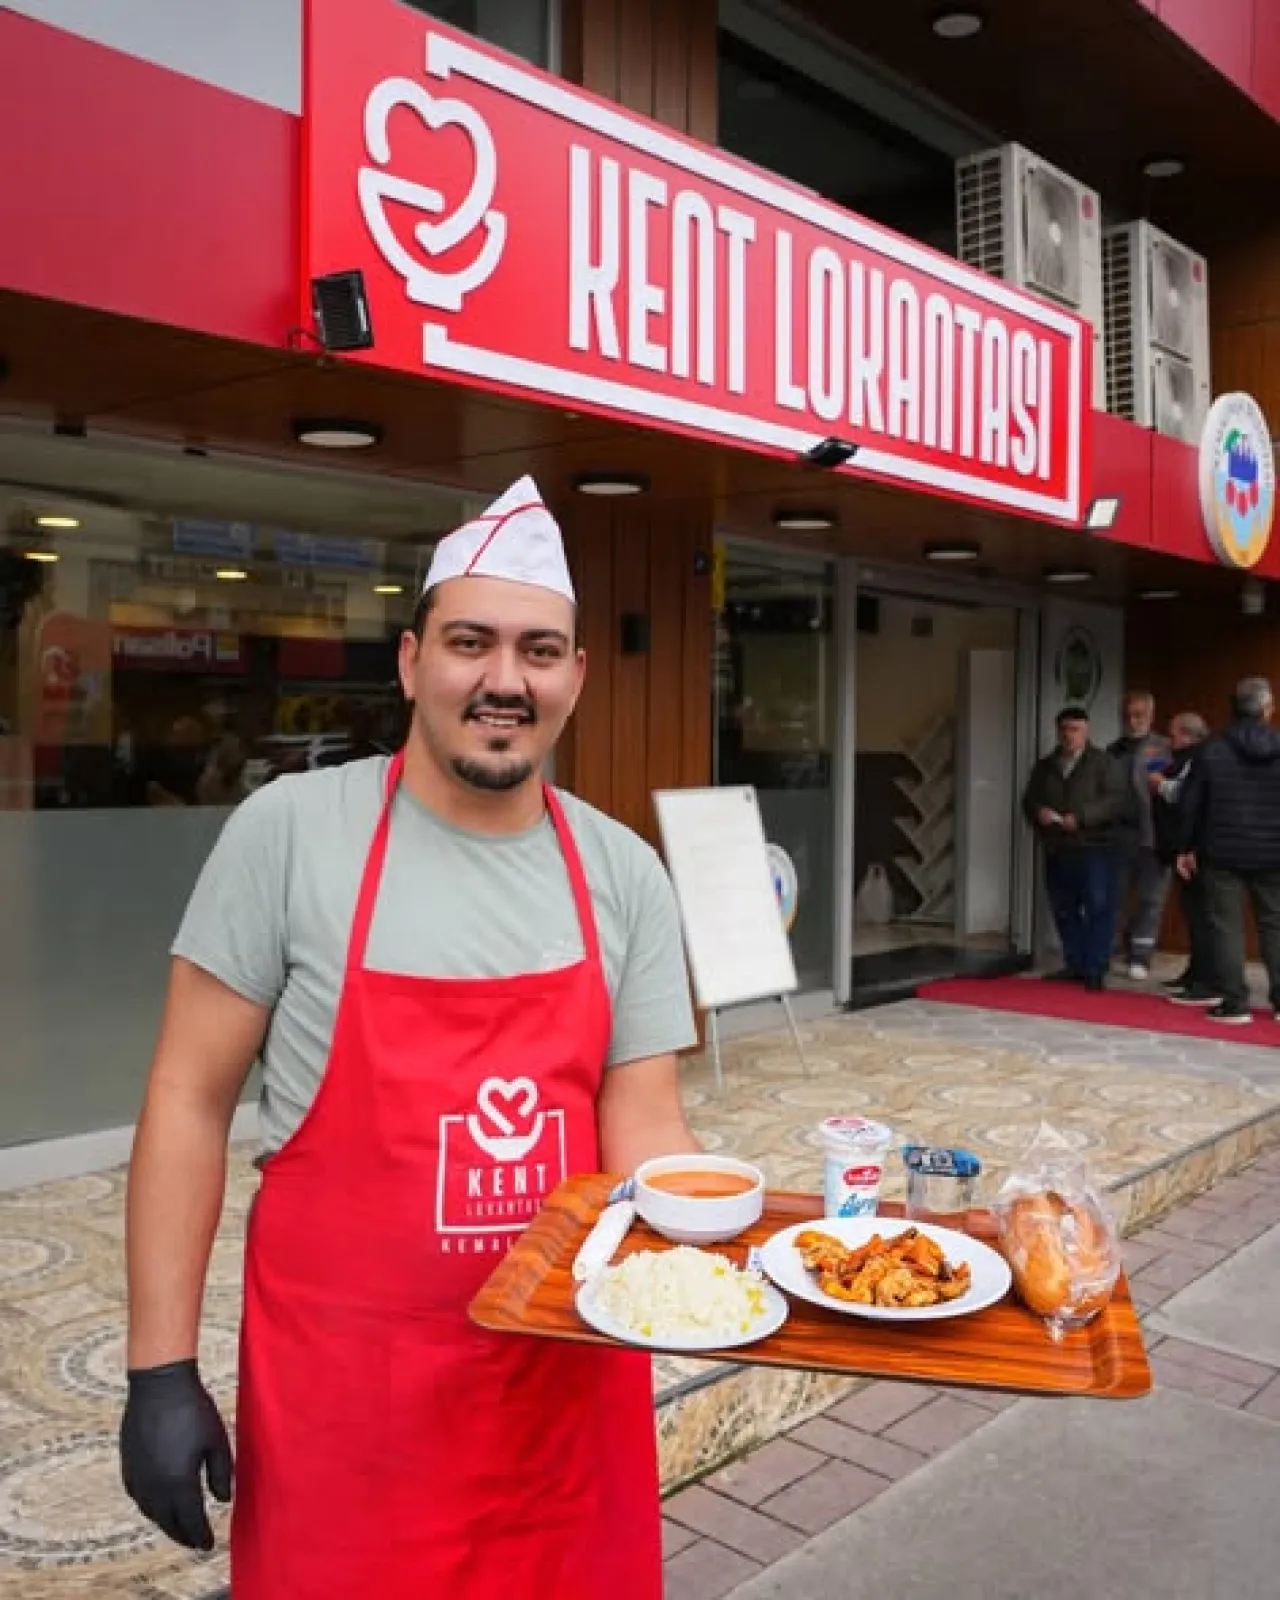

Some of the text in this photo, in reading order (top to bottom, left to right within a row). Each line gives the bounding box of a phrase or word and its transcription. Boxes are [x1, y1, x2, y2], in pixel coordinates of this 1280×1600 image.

[568, 144, 1052, 480] KENT LOKANTASI
[467, 1163, 546, 1196] KENT
